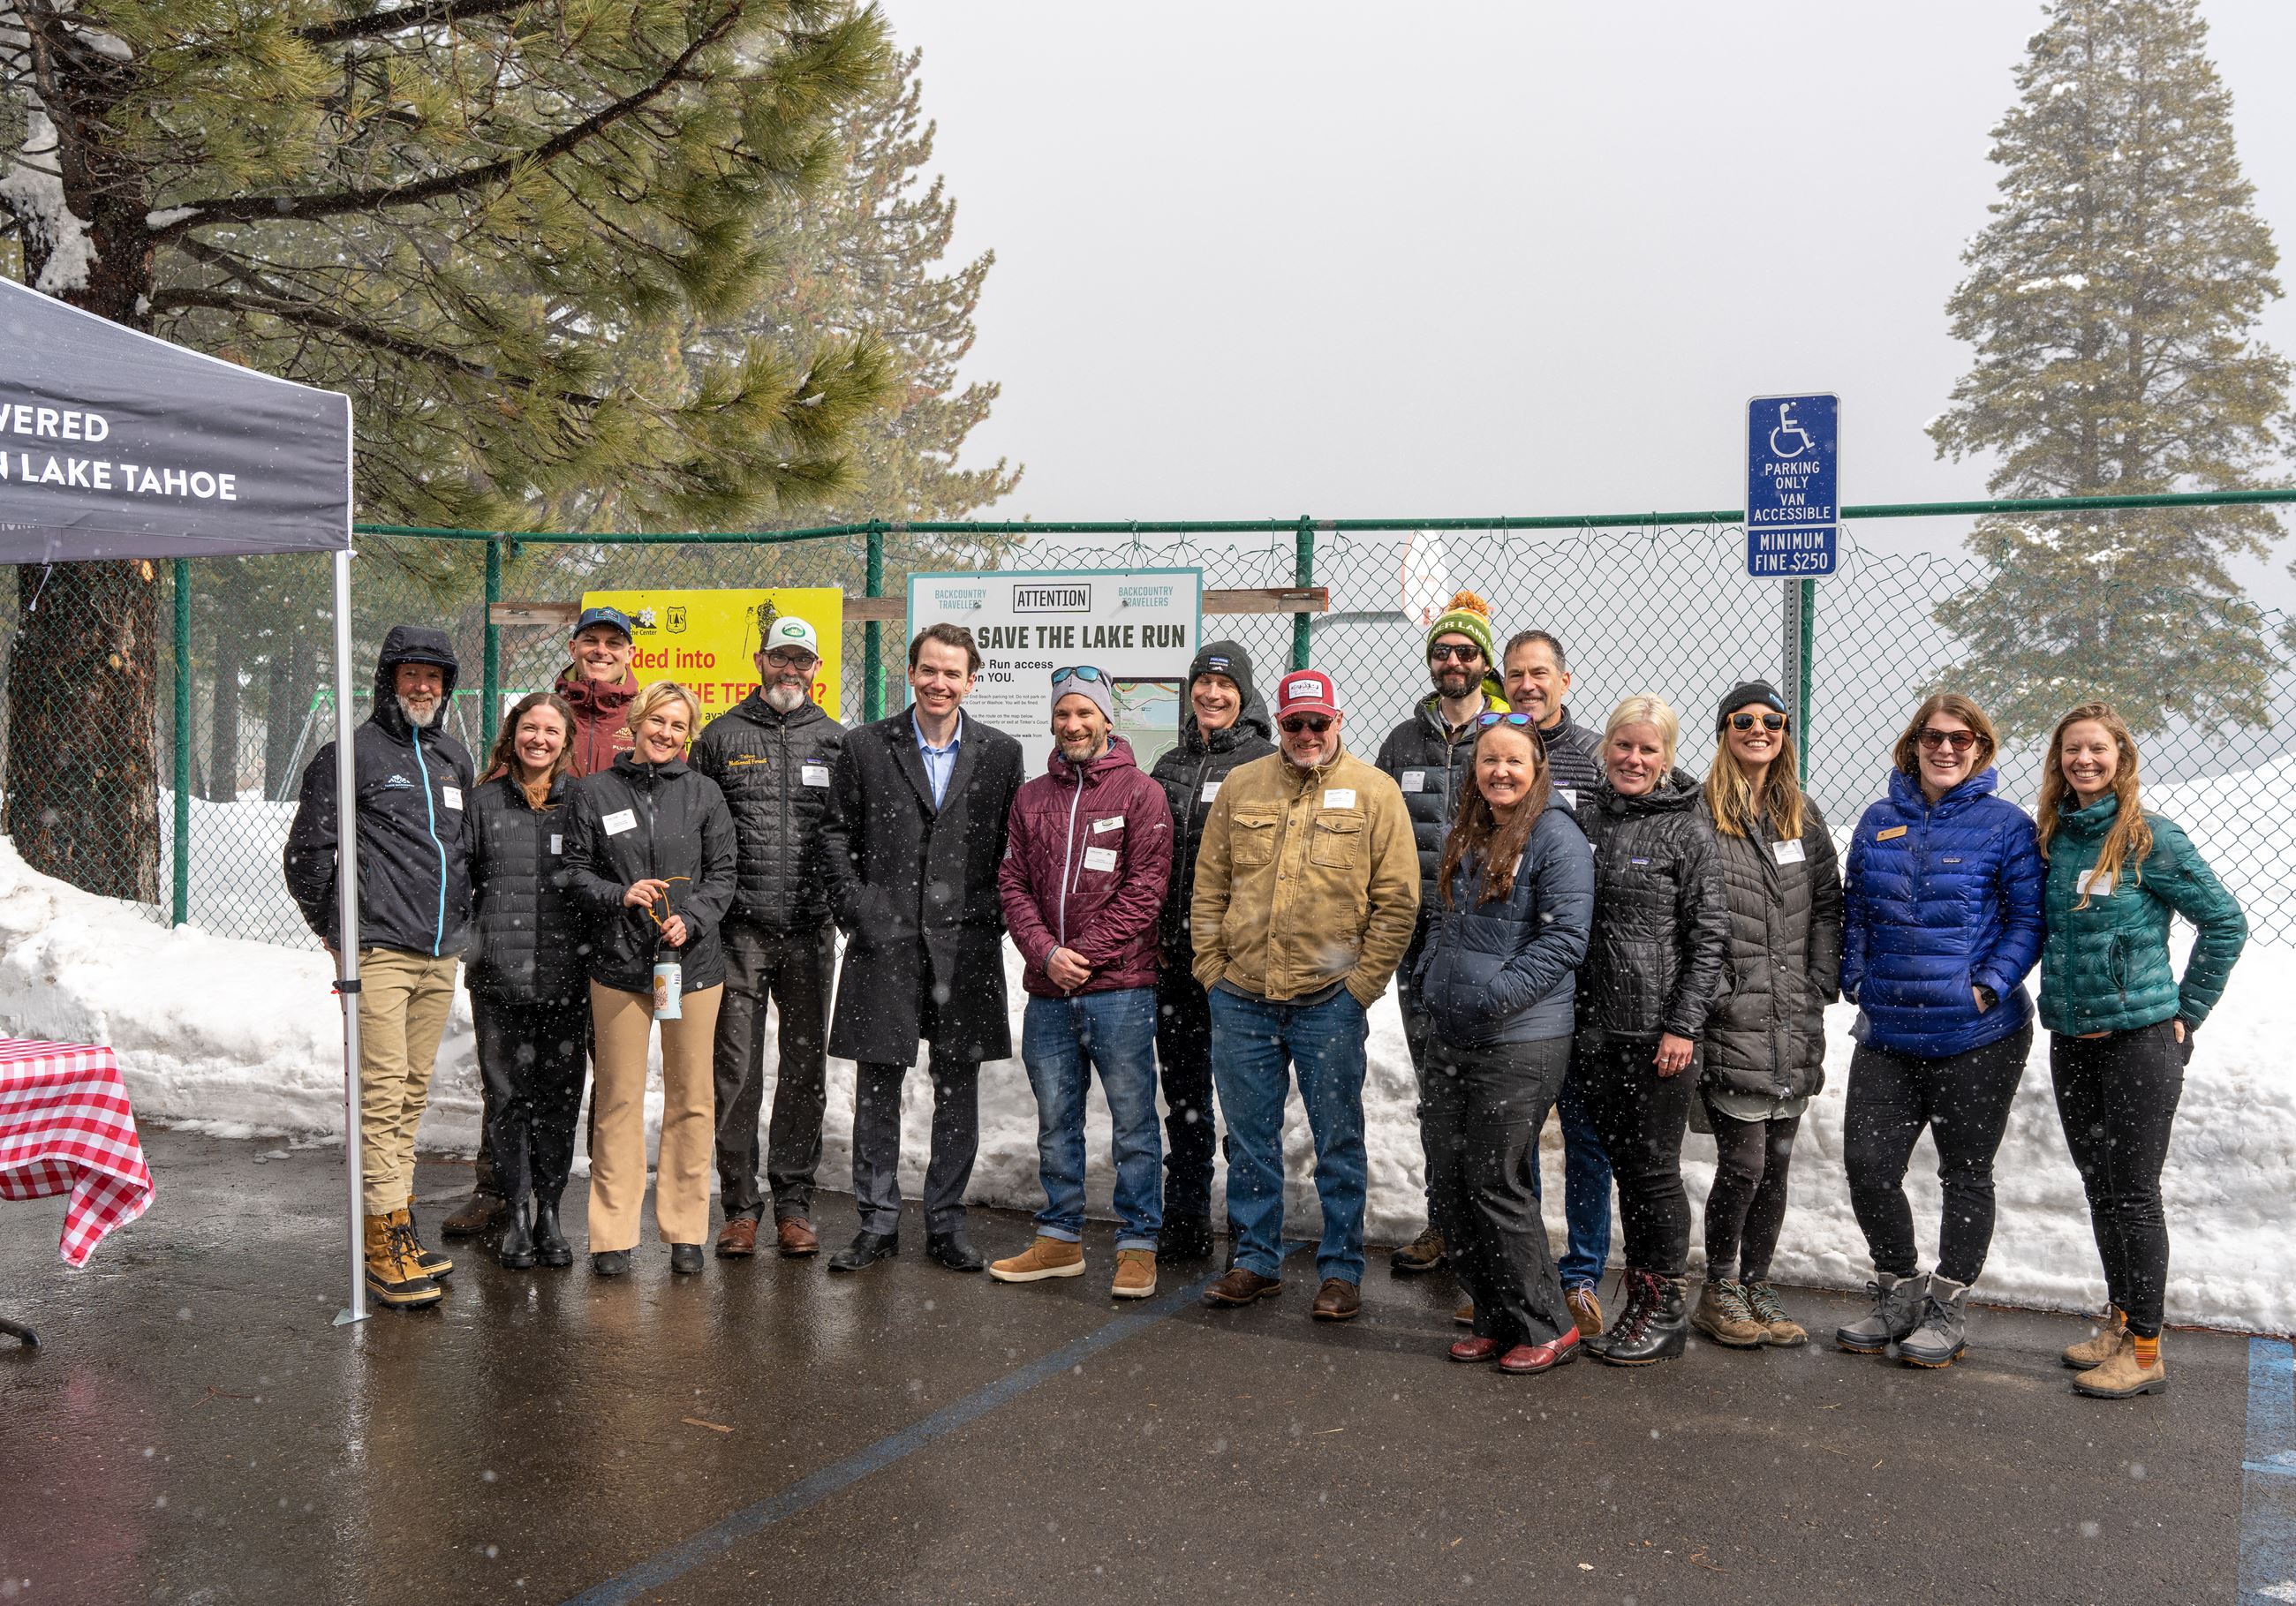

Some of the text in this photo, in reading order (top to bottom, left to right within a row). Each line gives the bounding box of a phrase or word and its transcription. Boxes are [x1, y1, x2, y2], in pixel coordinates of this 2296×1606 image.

[21, 452, 112, 490] LAKE
[119, 464, 238, 501] TAHOE
[1764, 461, 1820, 476] PARKING
[1775, 476, 1809, 489] ONLY
[1780, 493, 1805, 506] VAN
[1754, 506, 1831, 522] ACCESSIBLE
[1760, 532, 1824, 551] MINIMUM
[1755, 552, 1828, 572] FINE $250
[934, 589, 986, 599] BACKCOUNTRY
[1017, 590, 1086, 607] ATTENTION
[1118, 586, 1174, 597] BACKCOUNTRY
[978, 626, 1030, 649] SAVE
[1035, 625, 1075, 649] THE
[1082, 625, 1134, 649] LAKE
[1142, 624, 1185, 648] RUN
[1457, 621, 1487, 644] LAND
[676, 647, 715, 668] into
[989, 660, 1010, 669] Run
[1014, 660, 1054, 669] access
[987, 672, 1015, 682] YOU.
